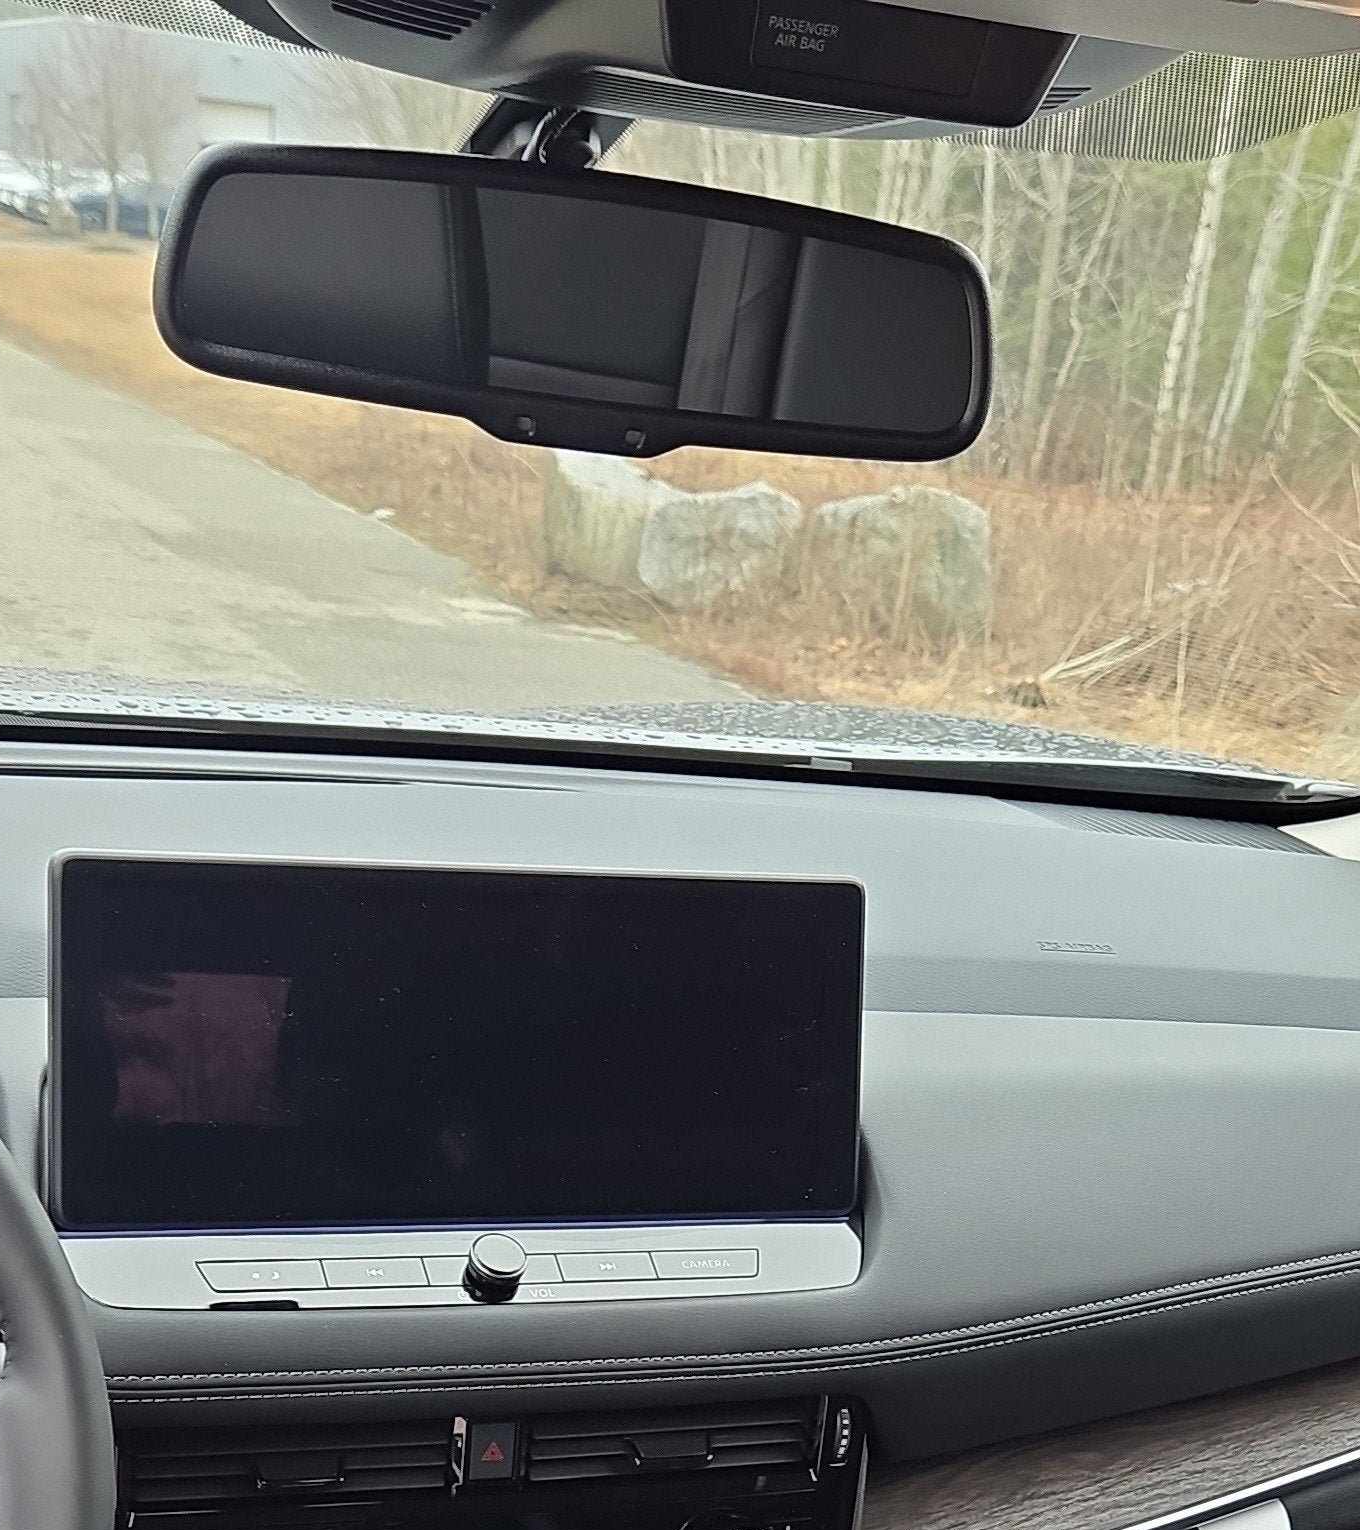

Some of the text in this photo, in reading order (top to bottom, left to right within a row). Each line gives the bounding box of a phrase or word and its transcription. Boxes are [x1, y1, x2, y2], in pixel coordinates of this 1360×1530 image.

[768, 15, 840, 39] PASSENGER
[775, 33, 826, 52] AIR BAG
[681, 1259, 731, 1269] CAMERA
[529, 1288, 556, 1298] VOL
